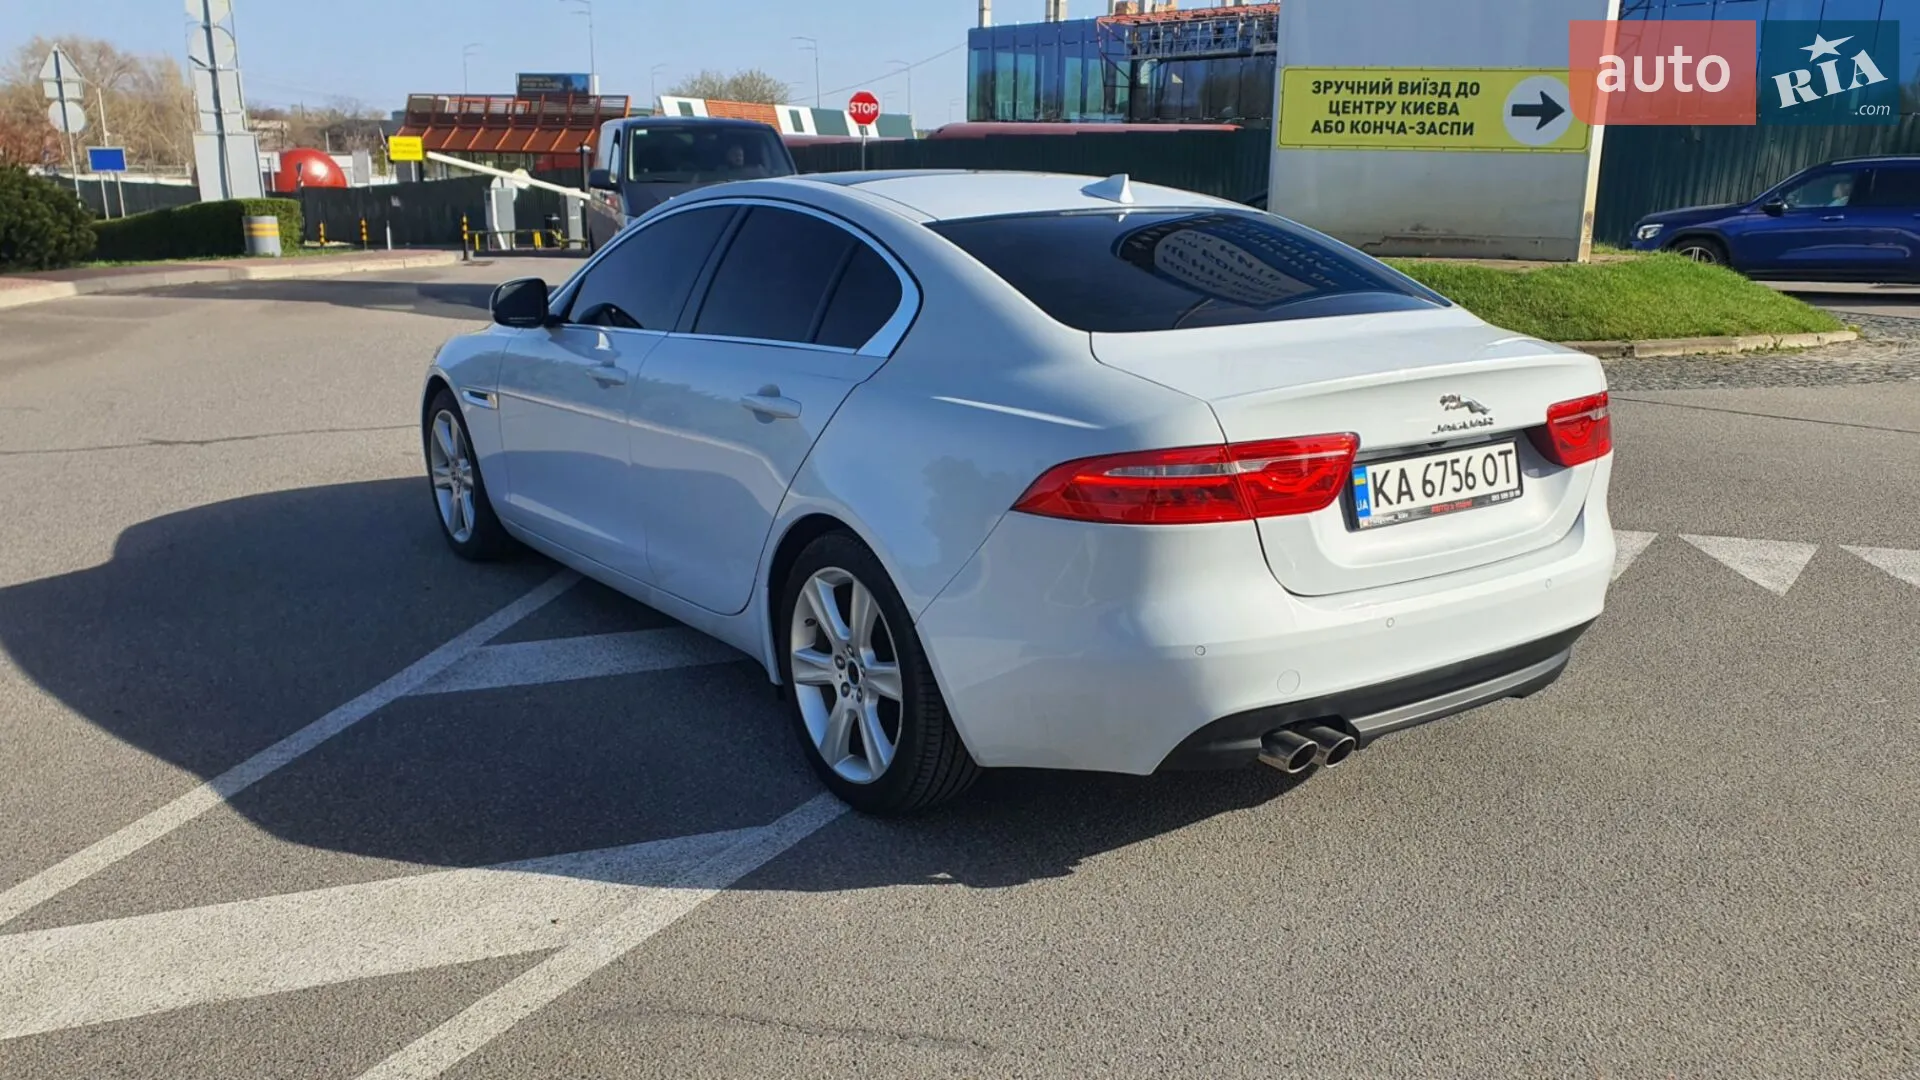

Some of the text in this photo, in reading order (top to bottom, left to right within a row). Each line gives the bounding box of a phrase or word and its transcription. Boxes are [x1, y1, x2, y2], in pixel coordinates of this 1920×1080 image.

[1312, 77, 1480, 98] ЗРУЧНИЙ ВИЇЗД ДО
[850, 102, 878, 114] STOP
[1328, 100, 1460, 116] ЦЕНТРУ КИЄВА
[1311, 120, 1474, 136] АБО КОНЧА-ЗАСПИ
[1421, 457, 1477, 498] 6756
[1356, 501, 1369, 512] UA
